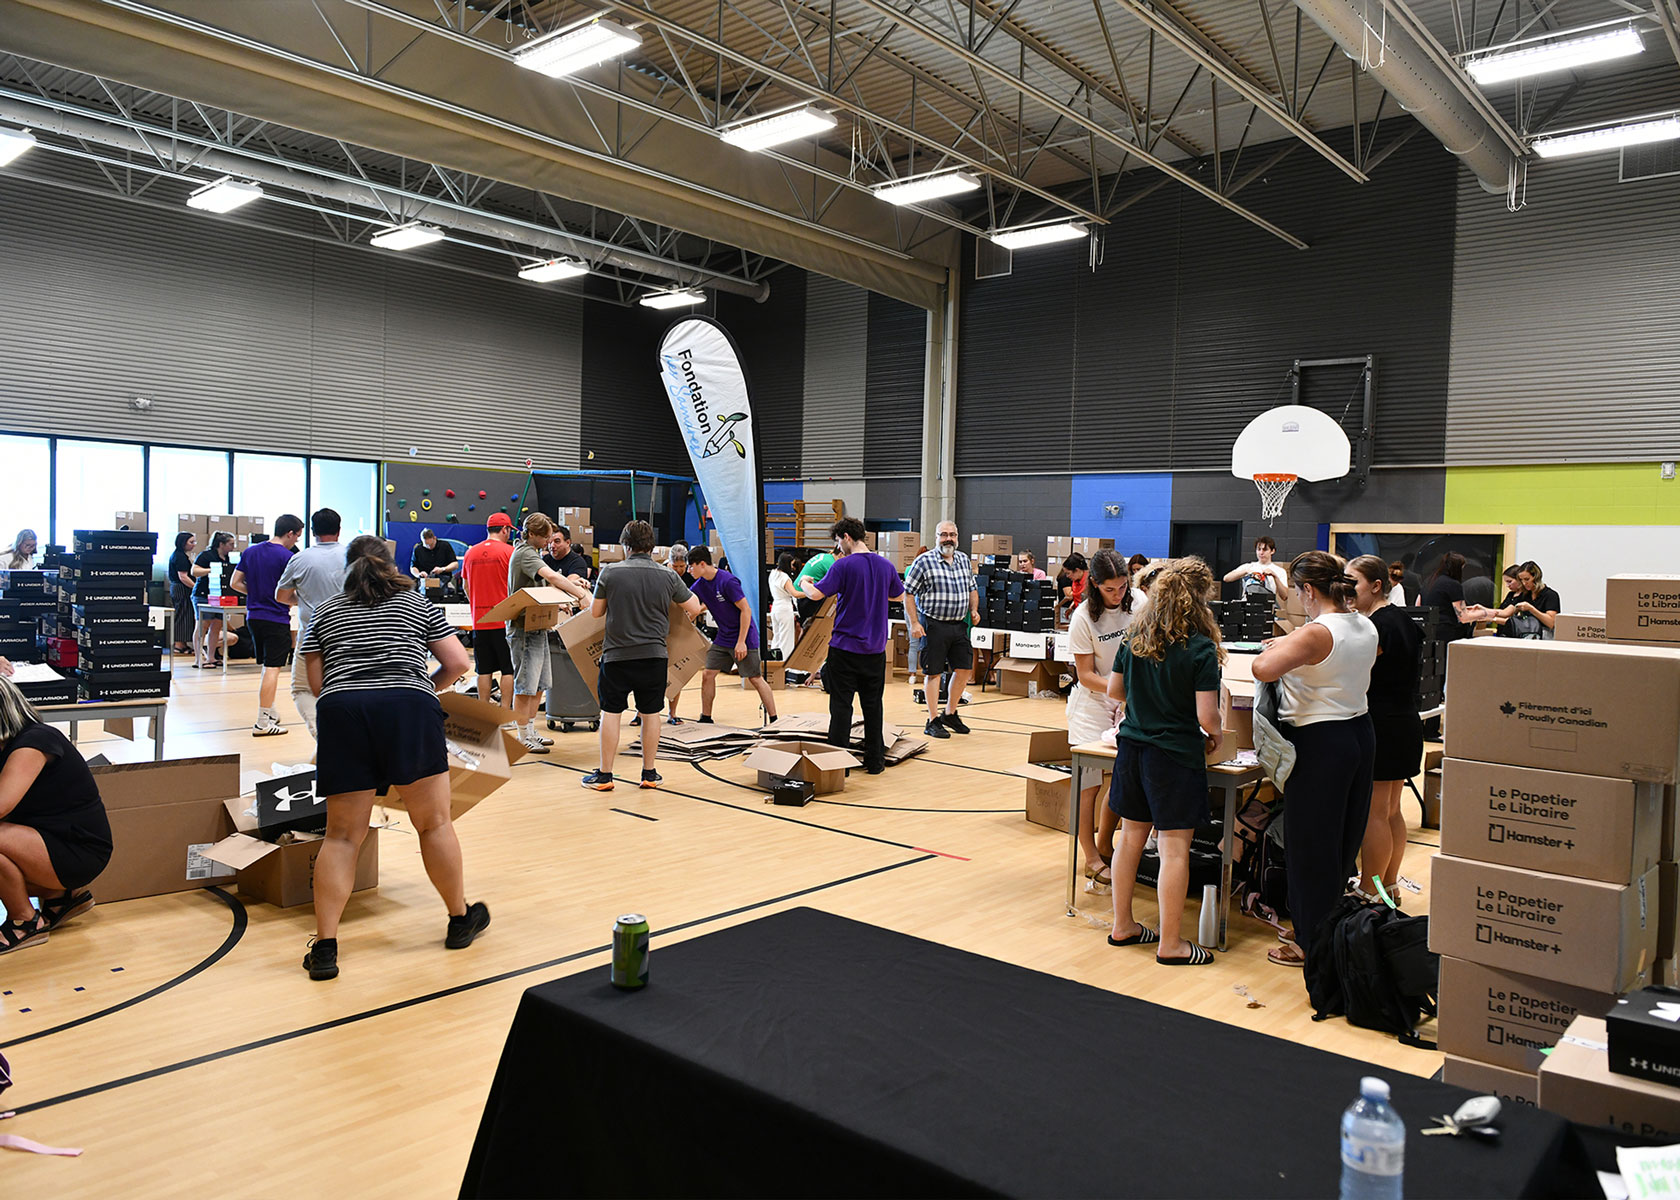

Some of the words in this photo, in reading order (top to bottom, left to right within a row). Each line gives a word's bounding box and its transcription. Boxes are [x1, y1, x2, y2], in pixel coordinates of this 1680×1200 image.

[678, 349, 712, 435] Fondation
[1638, 600, 1650, 608] Le
[1518, 712, 1556, 724] Proudly
[1557, 716, 1608, 728] Canadian
[1519, 701, 1568, 714] Fièrement
[1570, 706, 1592, 716] d'ici
[1490, 786, 1507, 798] Le
[1511, 789, 1577, 807] Papetier
[1489, 799, 1506, 811] Le
[1510, 802, 1569, 820] Libraire
[1477, 886, 1494, 899] Le
[1498, 890, 1564, 912] Papetier
[1477, 899, 1494, 912] Le
[1498, 903, 1556, 925] Libraire
[1488, 987, 1506, 1000] Le
[1510, 992, 1578, 1015] Papetier
[1488, 1000, 1505, 1013] Le
[1509, 1005, 1570, 1028] Libraire
